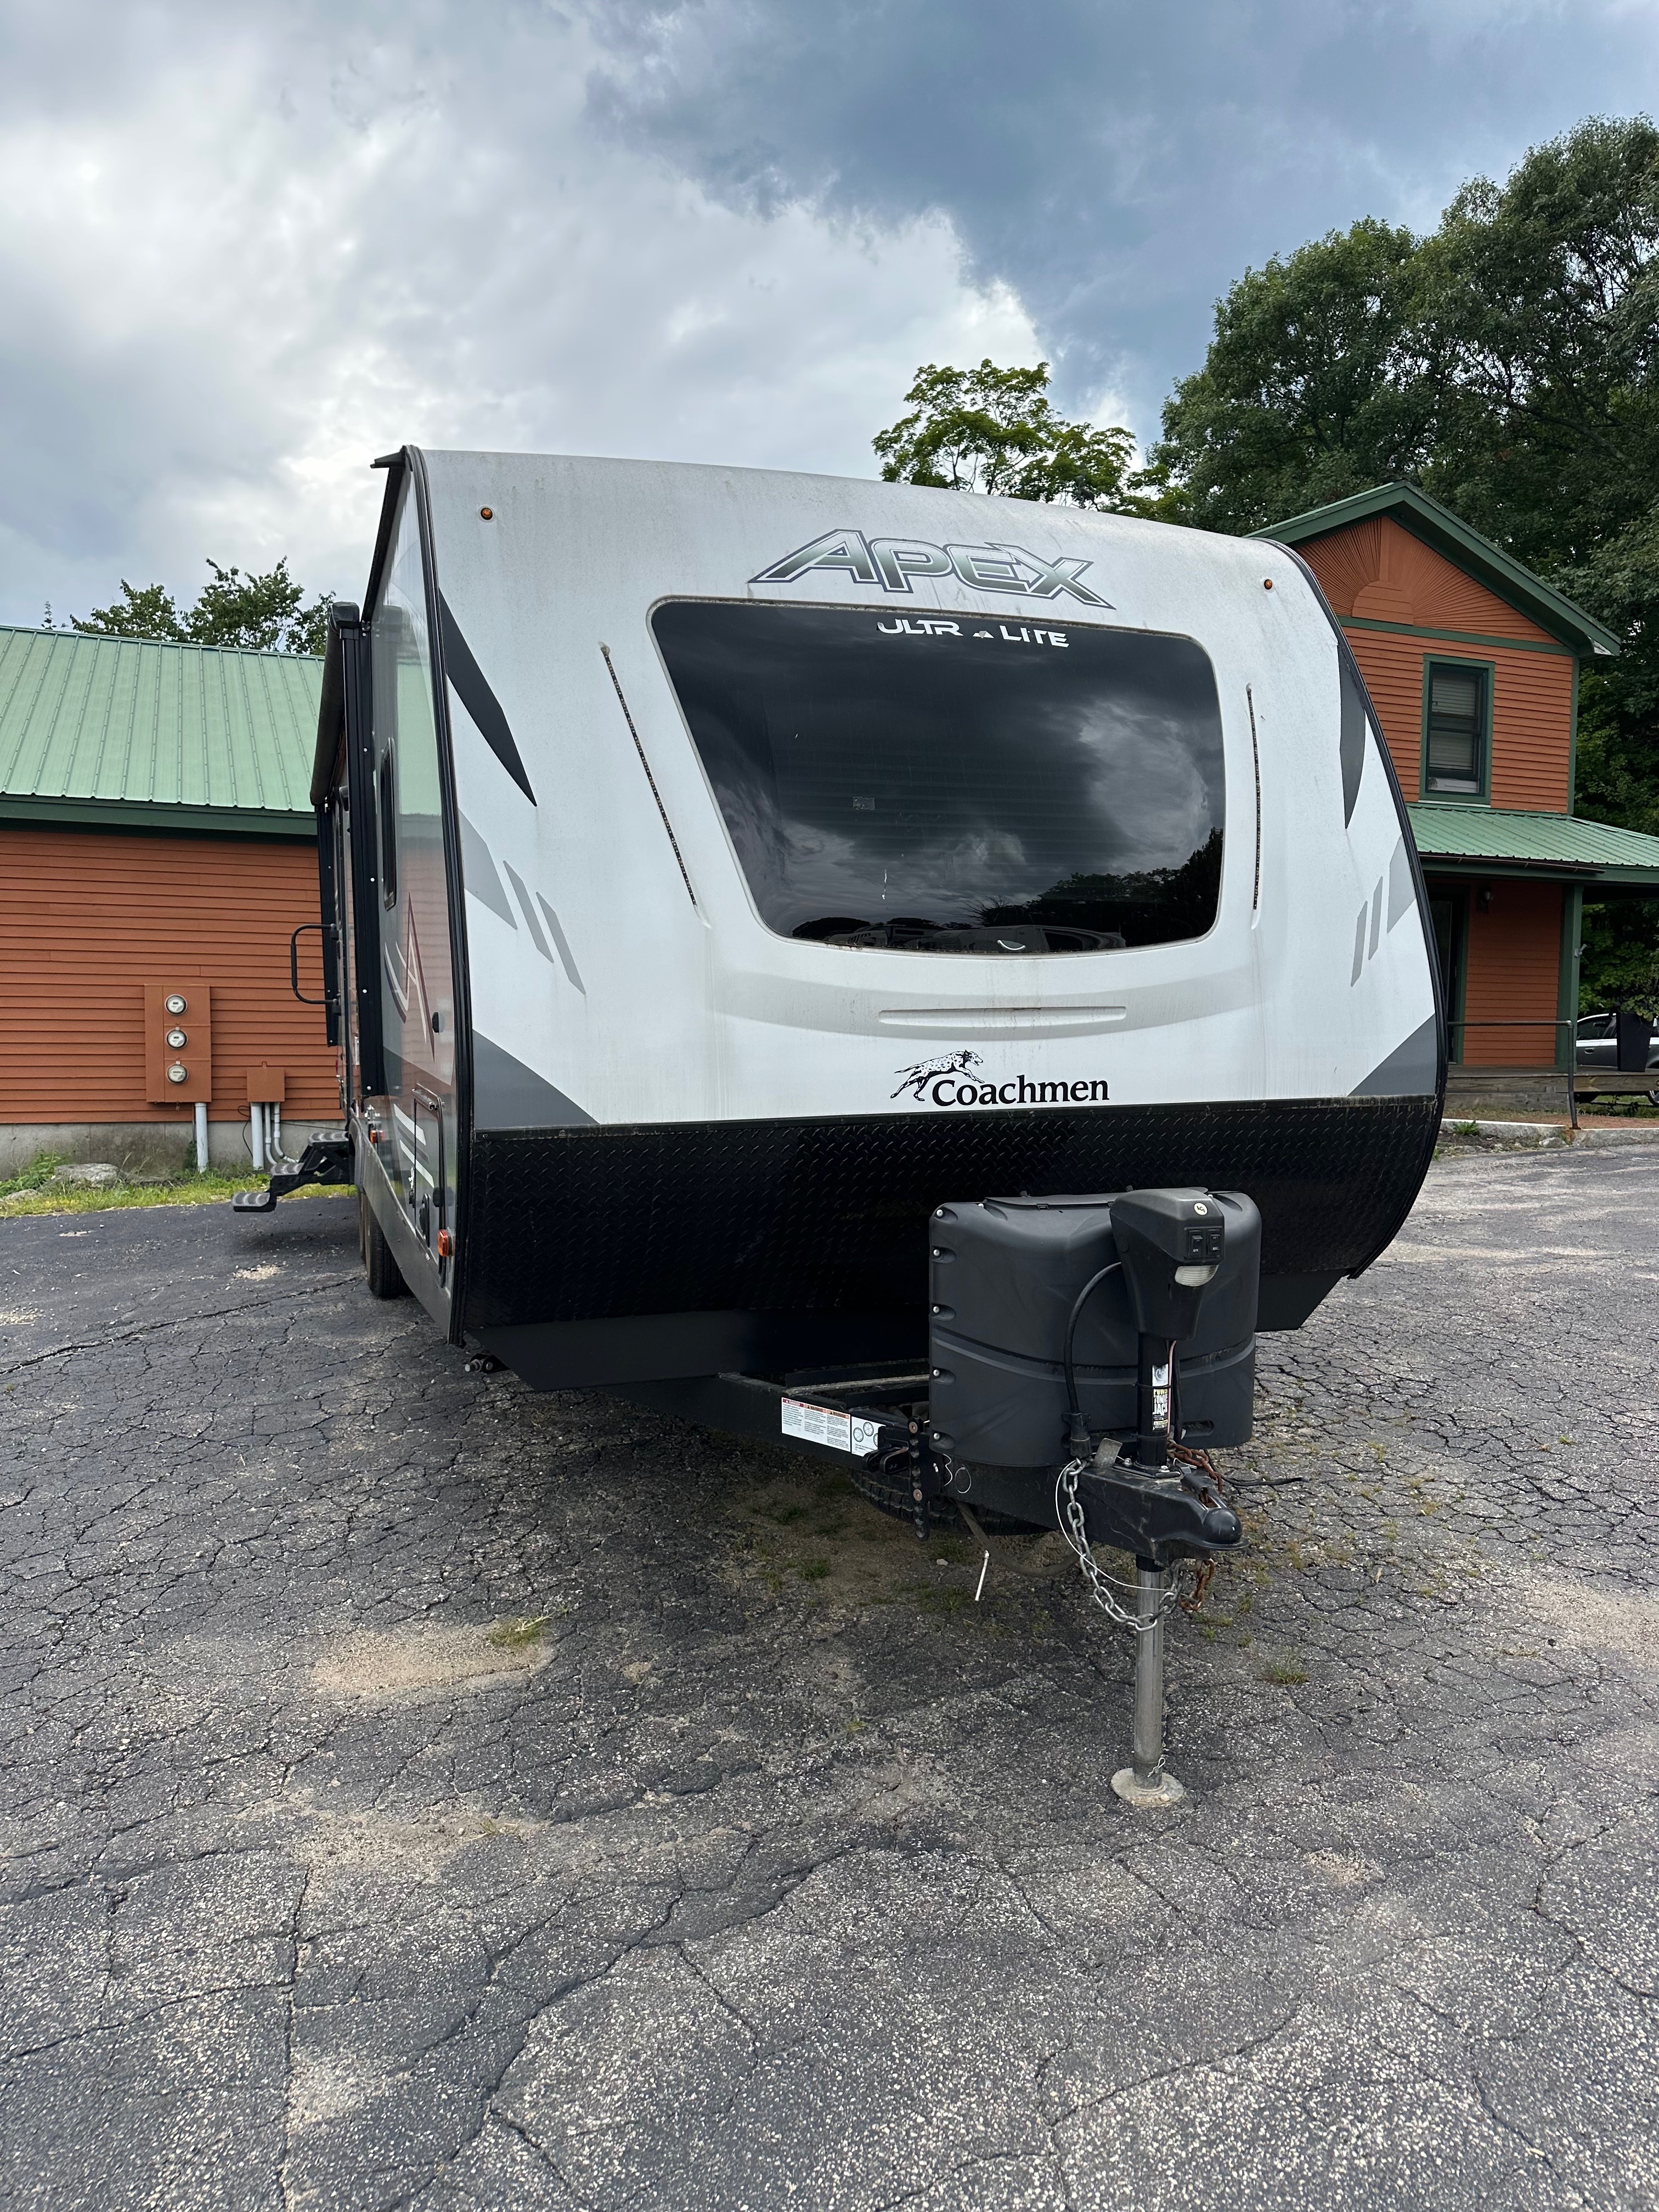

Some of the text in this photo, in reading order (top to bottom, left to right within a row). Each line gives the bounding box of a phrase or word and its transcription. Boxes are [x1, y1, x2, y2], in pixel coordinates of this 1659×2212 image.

[747, 528, 1117, 610] APEX
[999, 625, 1070, 648] LITE
[932, 1074, 1110, 1107] Coachmen
